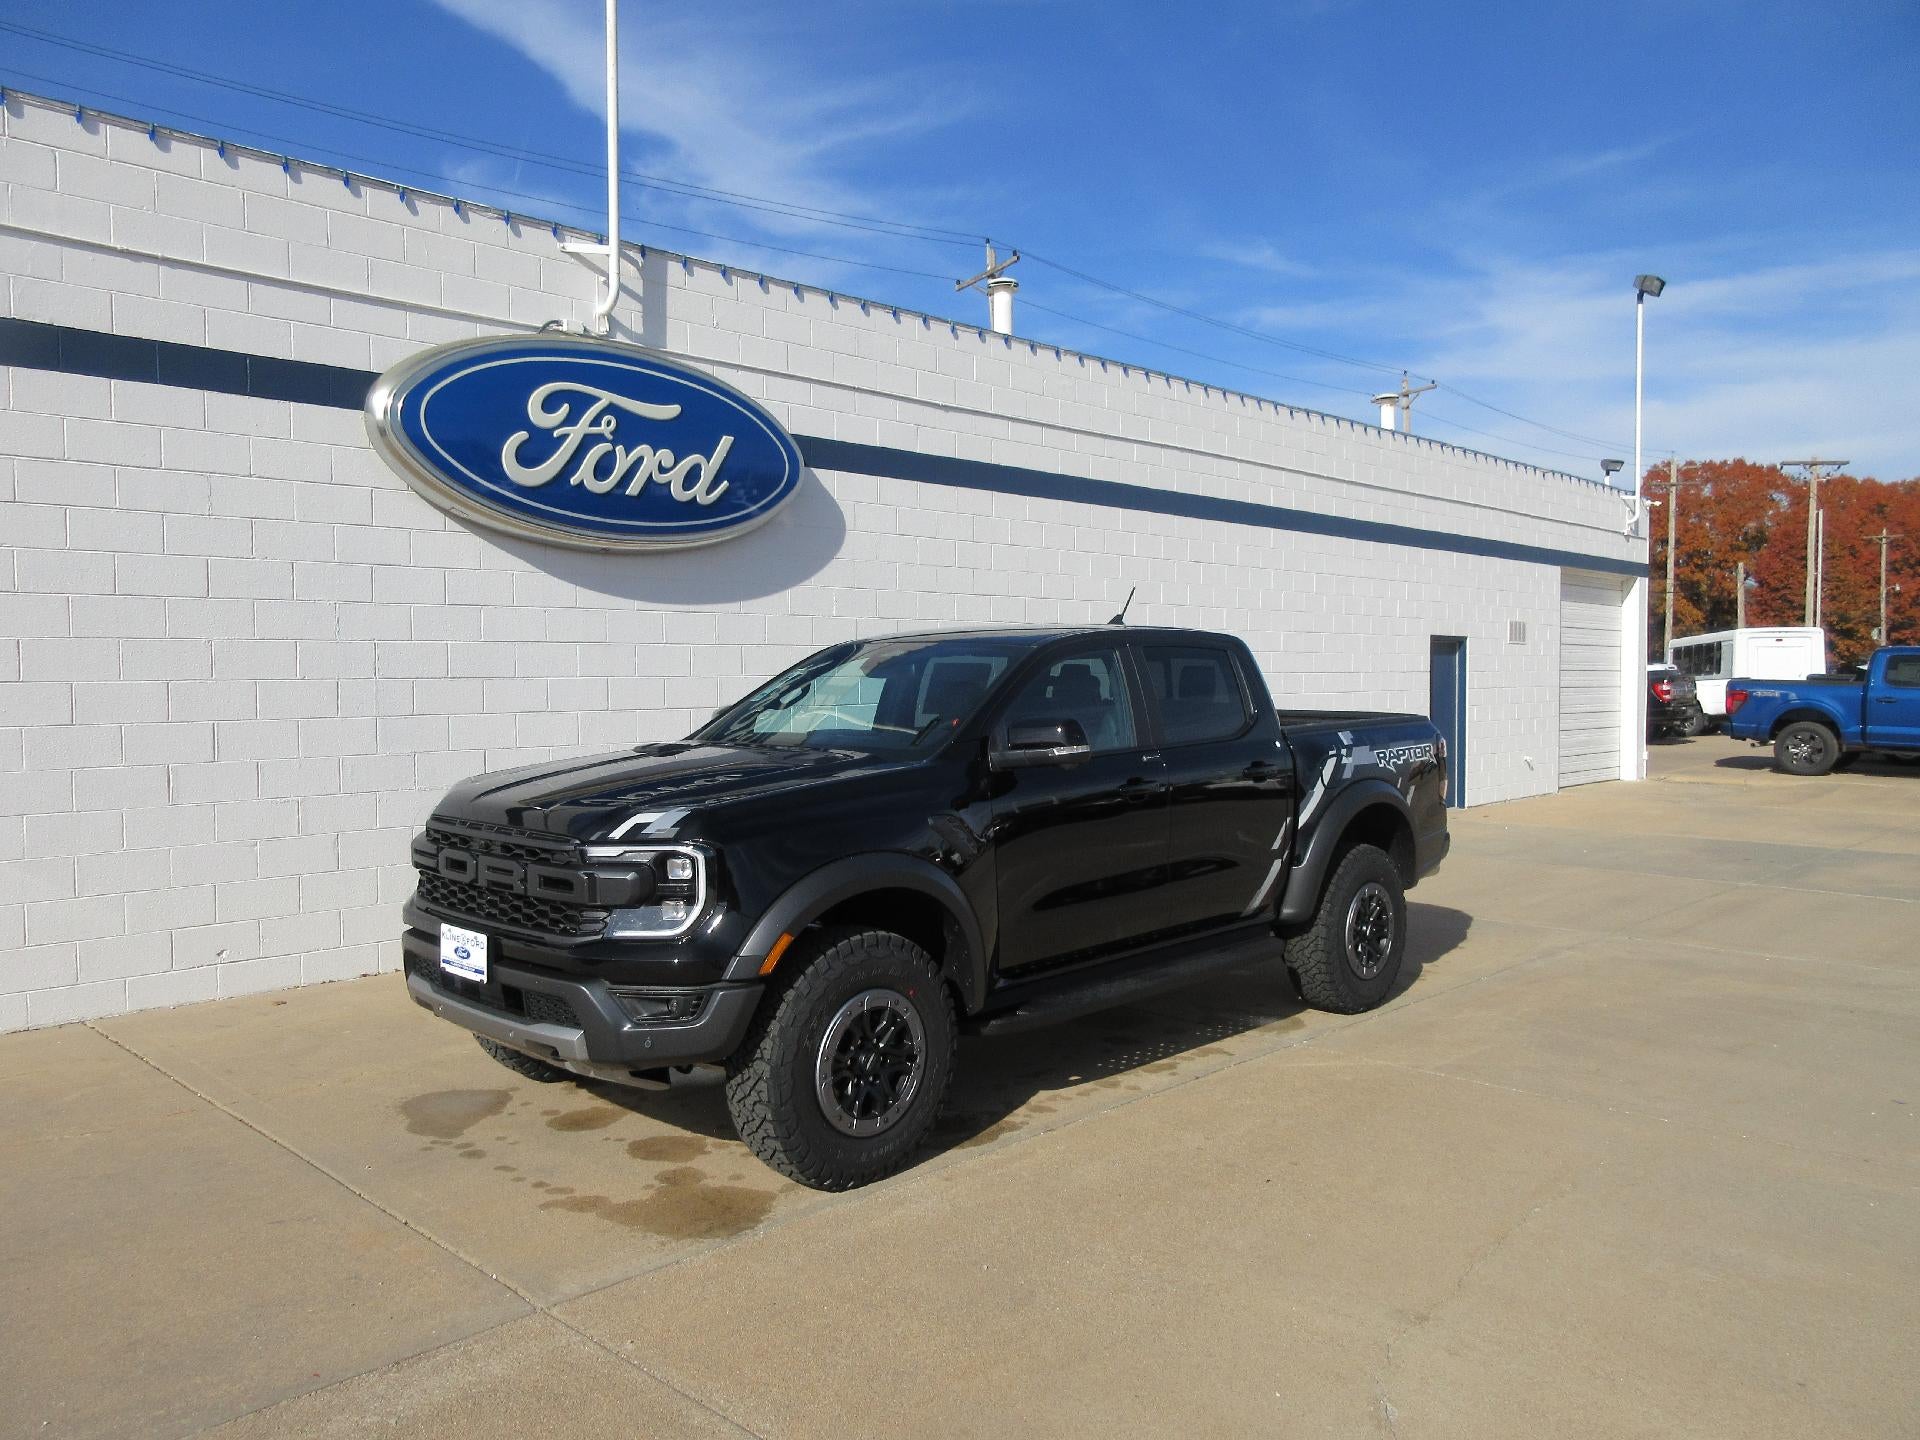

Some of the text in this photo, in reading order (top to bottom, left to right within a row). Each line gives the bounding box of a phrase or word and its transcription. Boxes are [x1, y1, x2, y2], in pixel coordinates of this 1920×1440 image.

[502, 381, 735, 506] Ford
[1374, 743, 1437, 773] RAPTOR
[411, 838, 594, 904] FORD
[441, 931, 461, 943] KLINE
